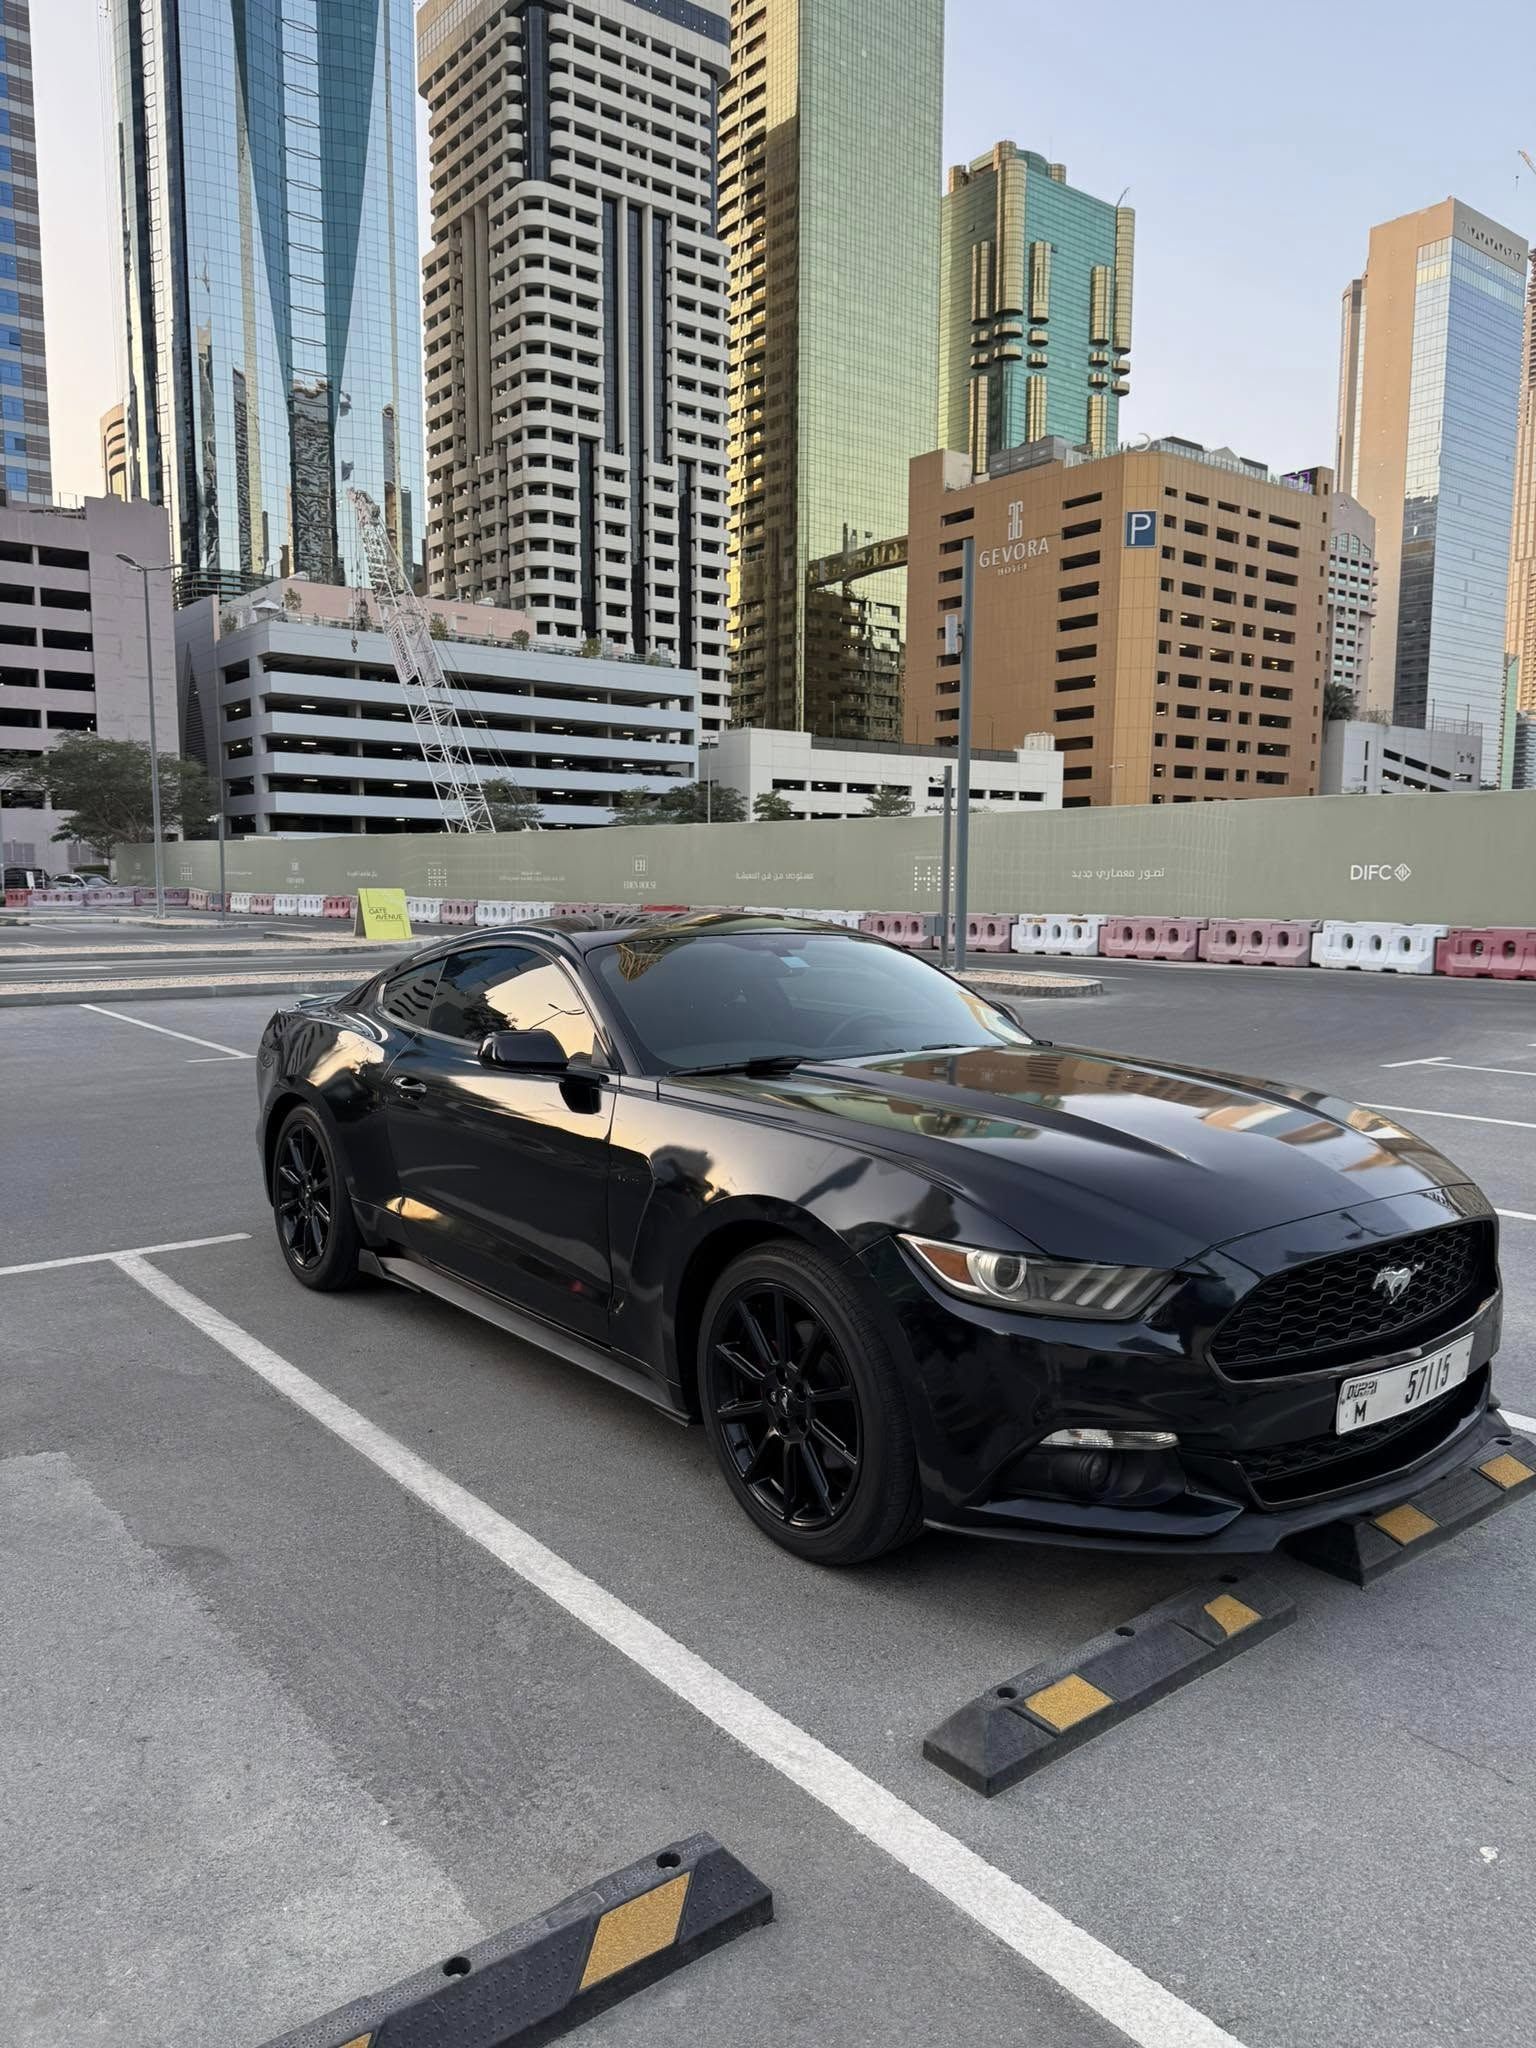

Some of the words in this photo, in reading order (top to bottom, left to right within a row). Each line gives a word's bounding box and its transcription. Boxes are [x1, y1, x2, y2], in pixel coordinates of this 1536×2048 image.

[1130, 513, 1152, 545] P
[979, 537, 1049, 568] GEVORA
[1350, 864, 1392, 880] DIFC
[368, 907, 386, 915] GATE
[1405, 1353, 1452, 1404] 57115
[1354, 1399, 1367, 1424] M
